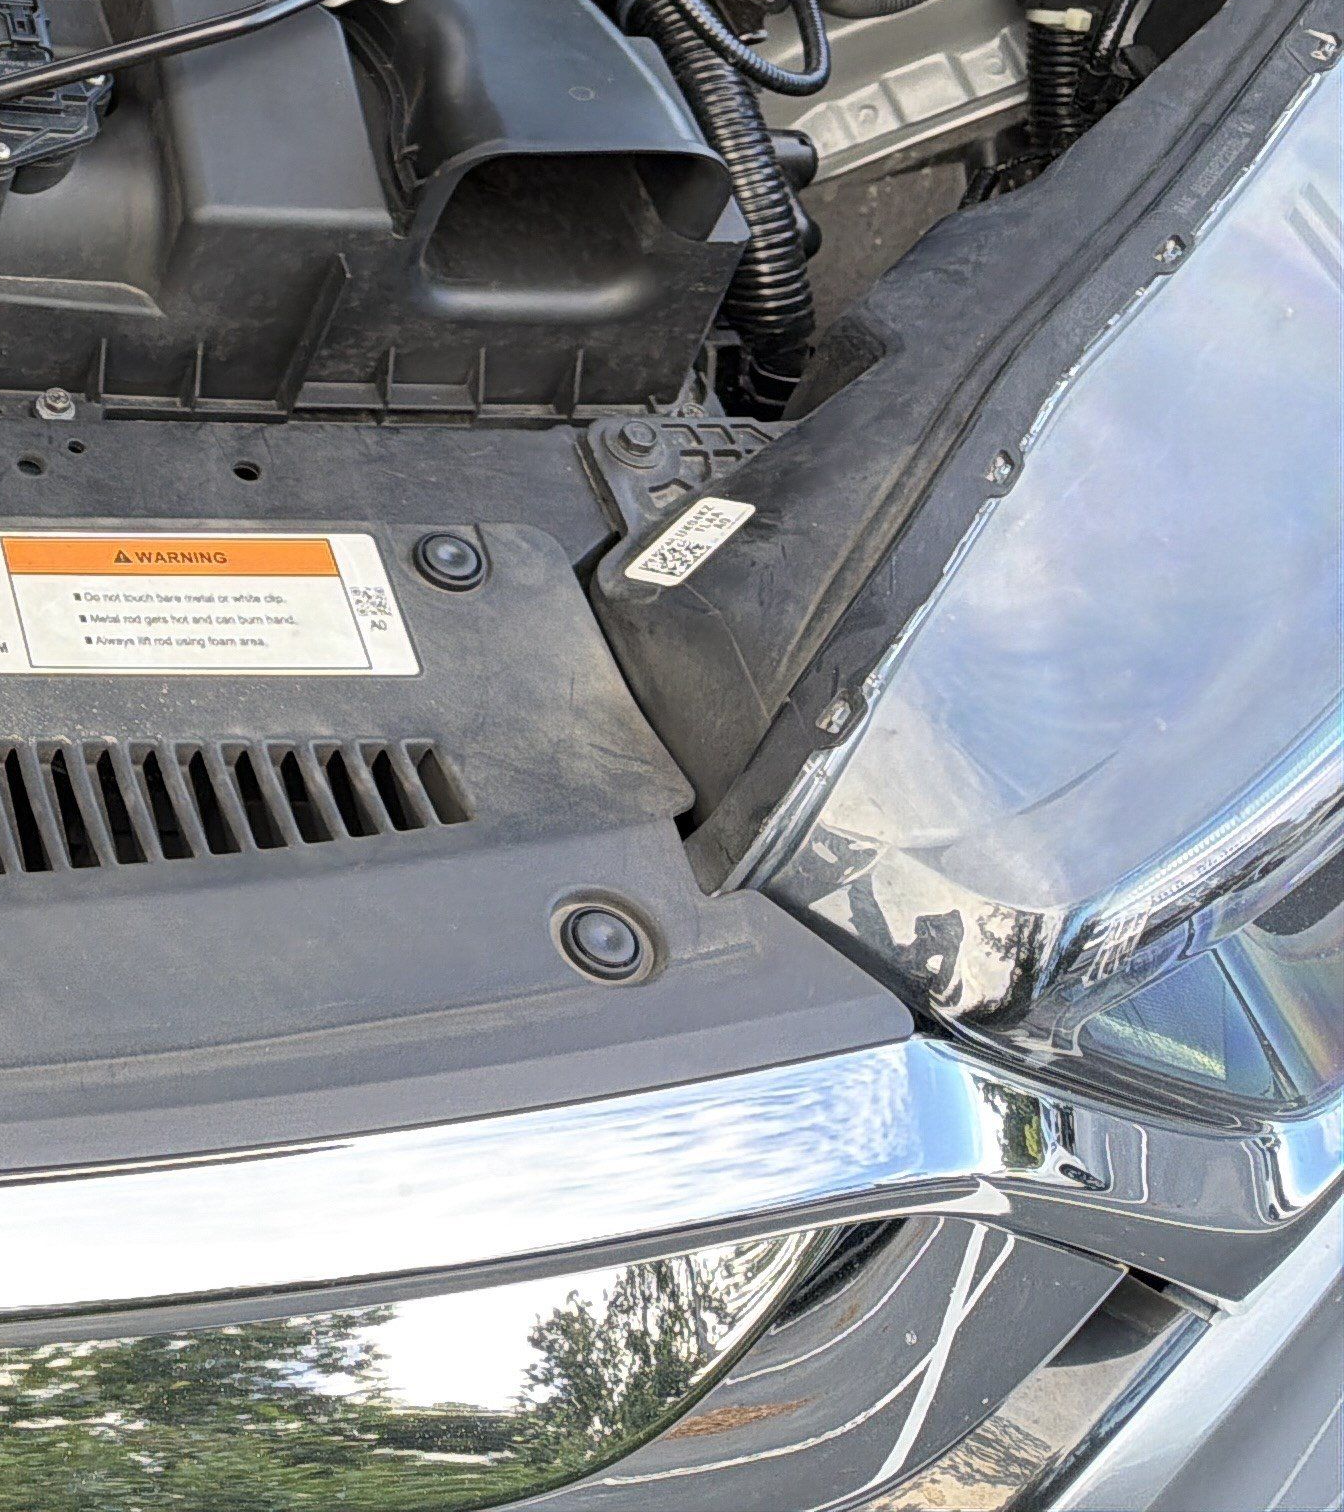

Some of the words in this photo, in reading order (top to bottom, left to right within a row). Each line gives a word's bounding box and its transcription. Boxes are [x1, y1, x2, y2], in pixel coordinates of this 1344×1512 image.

[135, 551, 228, 564] WARNING
[83, 591, 100, 602] Do
[103, 593, 121, 603] not
[123, 593, 153, 603] touch
[156, 593, 182, 603] bare
[184, 594, 215, 603] metal
[217, 595, 230, 604] or
[232, 594, 261, 603] white
[90, 614, 121, 624] Metal
[123, 615, 142, 624] rod
[144, 615, 168, 626] gets
[171, 615, 189, 624] hot
[192, 615, 213, 624] and
[216, 616, 235, 624] can
[237, 615, 263, 625] burn
[96, 636, 135, 648] Always
[138, 636, 151, 646] lift
[154, 637, 172, 646] rod
[176, 637, 206, 648] using
[208, 637, 237, 647] foam
